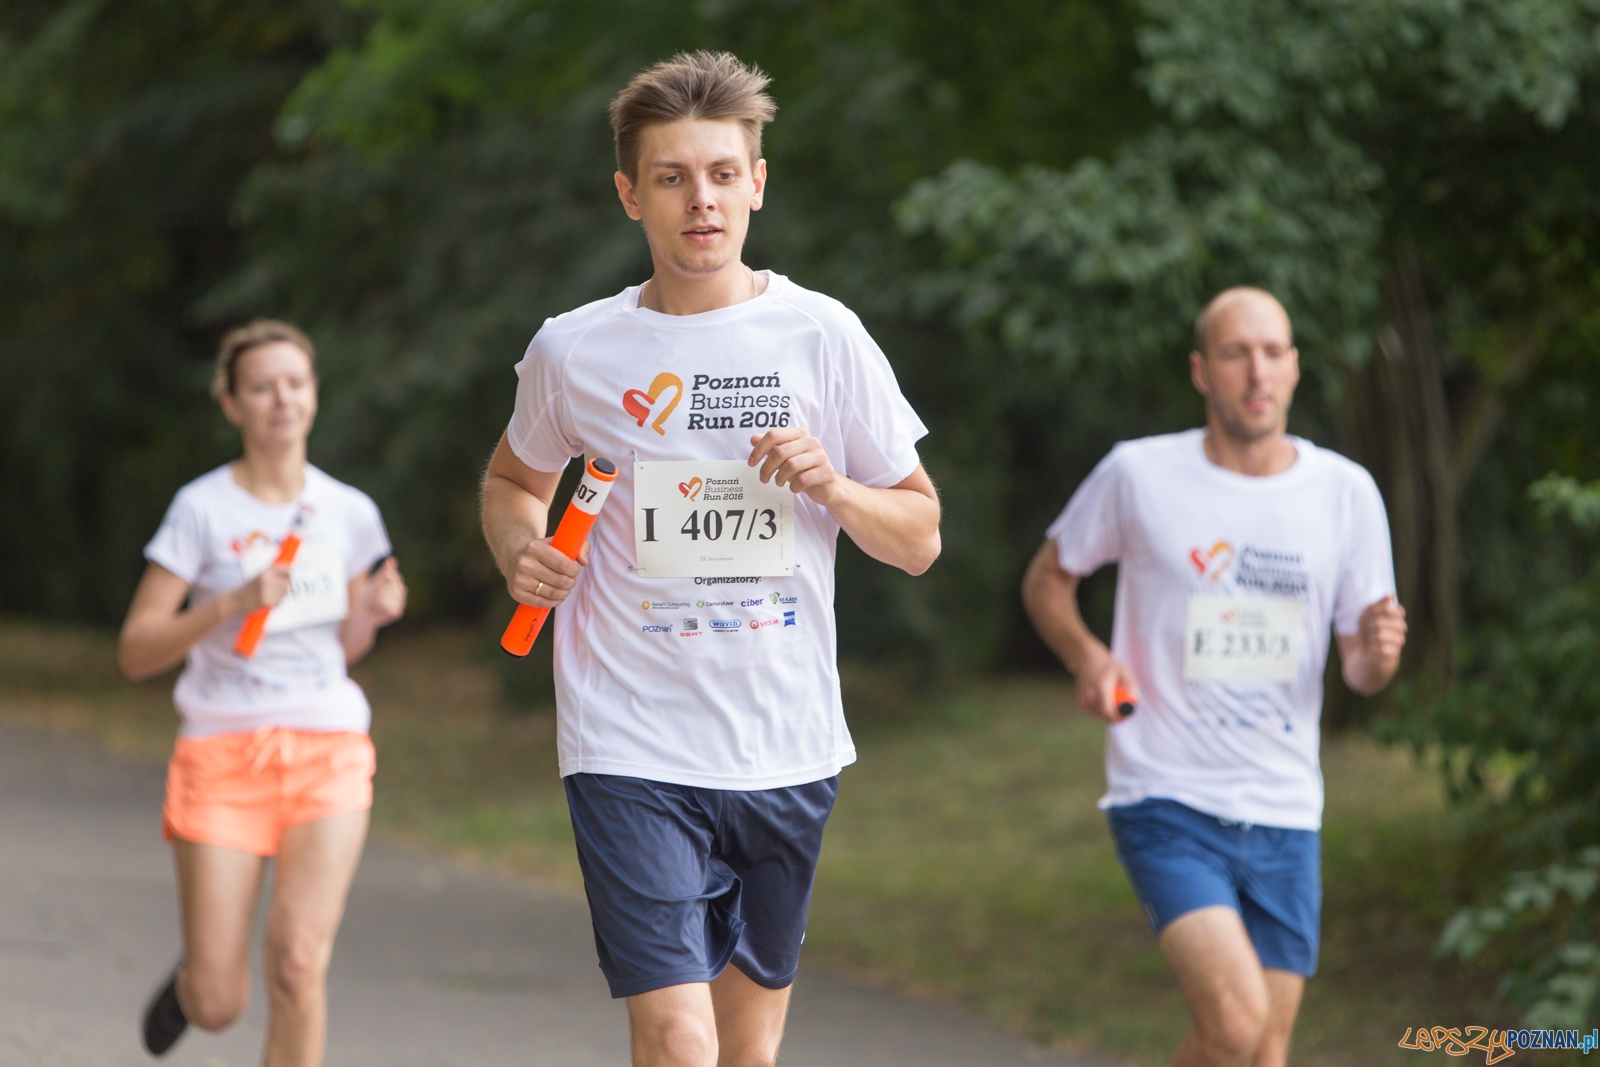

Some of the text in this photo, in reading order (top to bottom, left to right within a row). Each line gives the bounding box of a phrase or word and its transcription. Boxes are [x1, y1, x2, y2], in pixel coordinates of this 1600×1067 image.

[692, 372, 780, 390] Poznań
[690, 392, 790, 410] Business
[687, 411, 790, 430] Run 2016
[641, 507, 659, 542] I
[680, 508, 777, 541] 407/3
[741, 598, 764, 607] ciber
